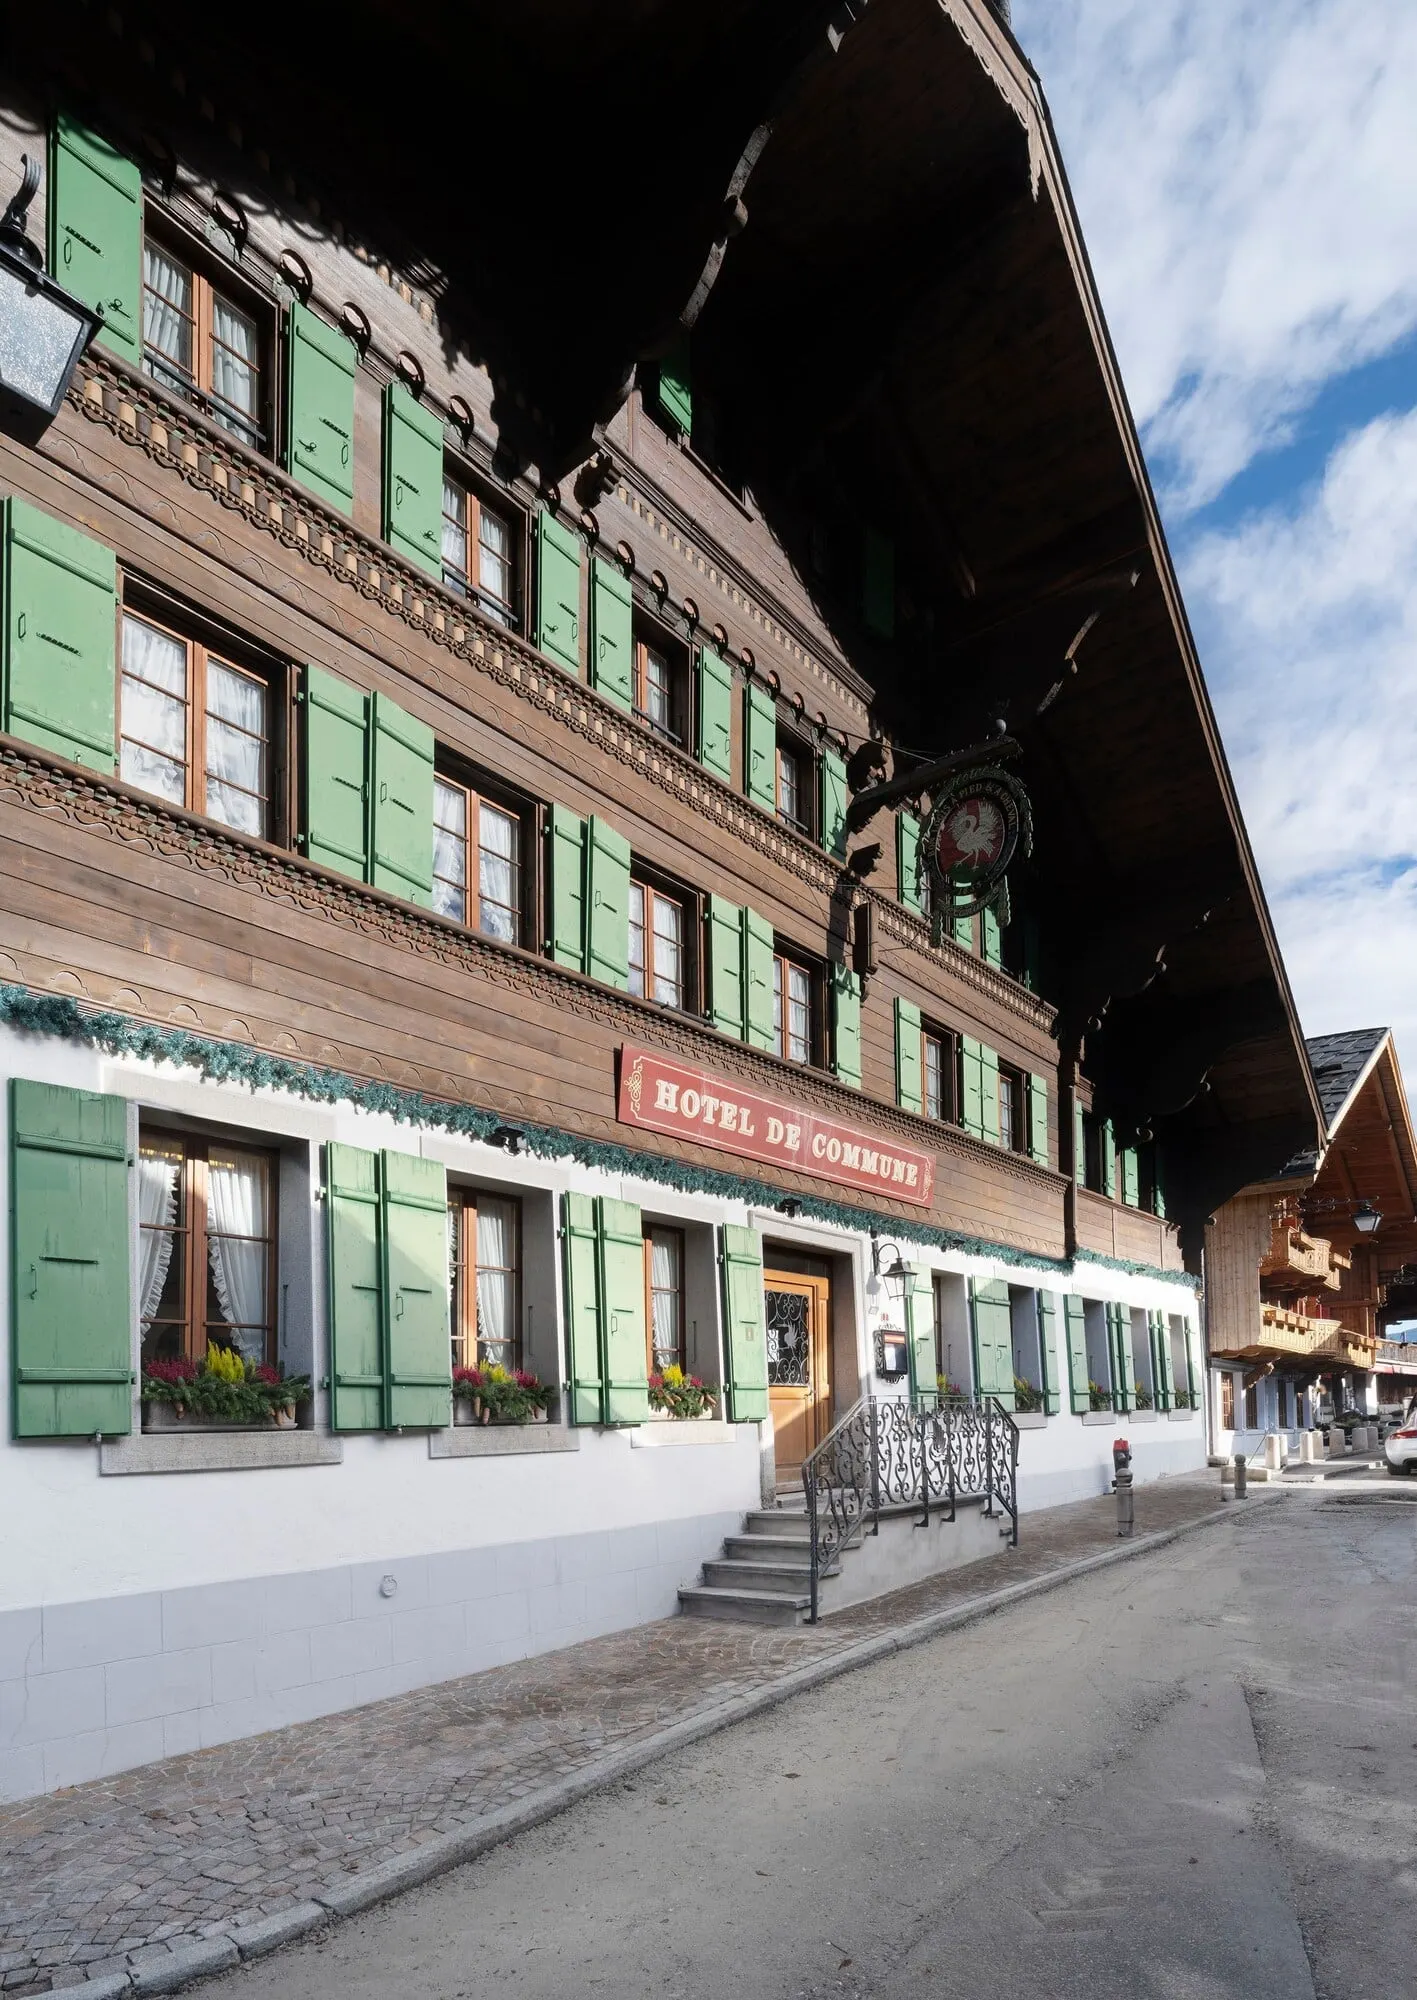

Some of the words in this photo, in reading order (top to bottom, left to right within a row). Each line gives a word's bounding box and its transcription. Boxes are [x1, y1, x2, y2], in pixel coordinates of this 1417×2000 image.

[959, 783, 983, 798] PIED
[1000, 791, 1017, 831] CHEVAL
[654, 1079, 755, 1137] HOTEL
[766, 1116, 801, 1151] DE
[812, 1132, 919, 1187] COMMUNE
